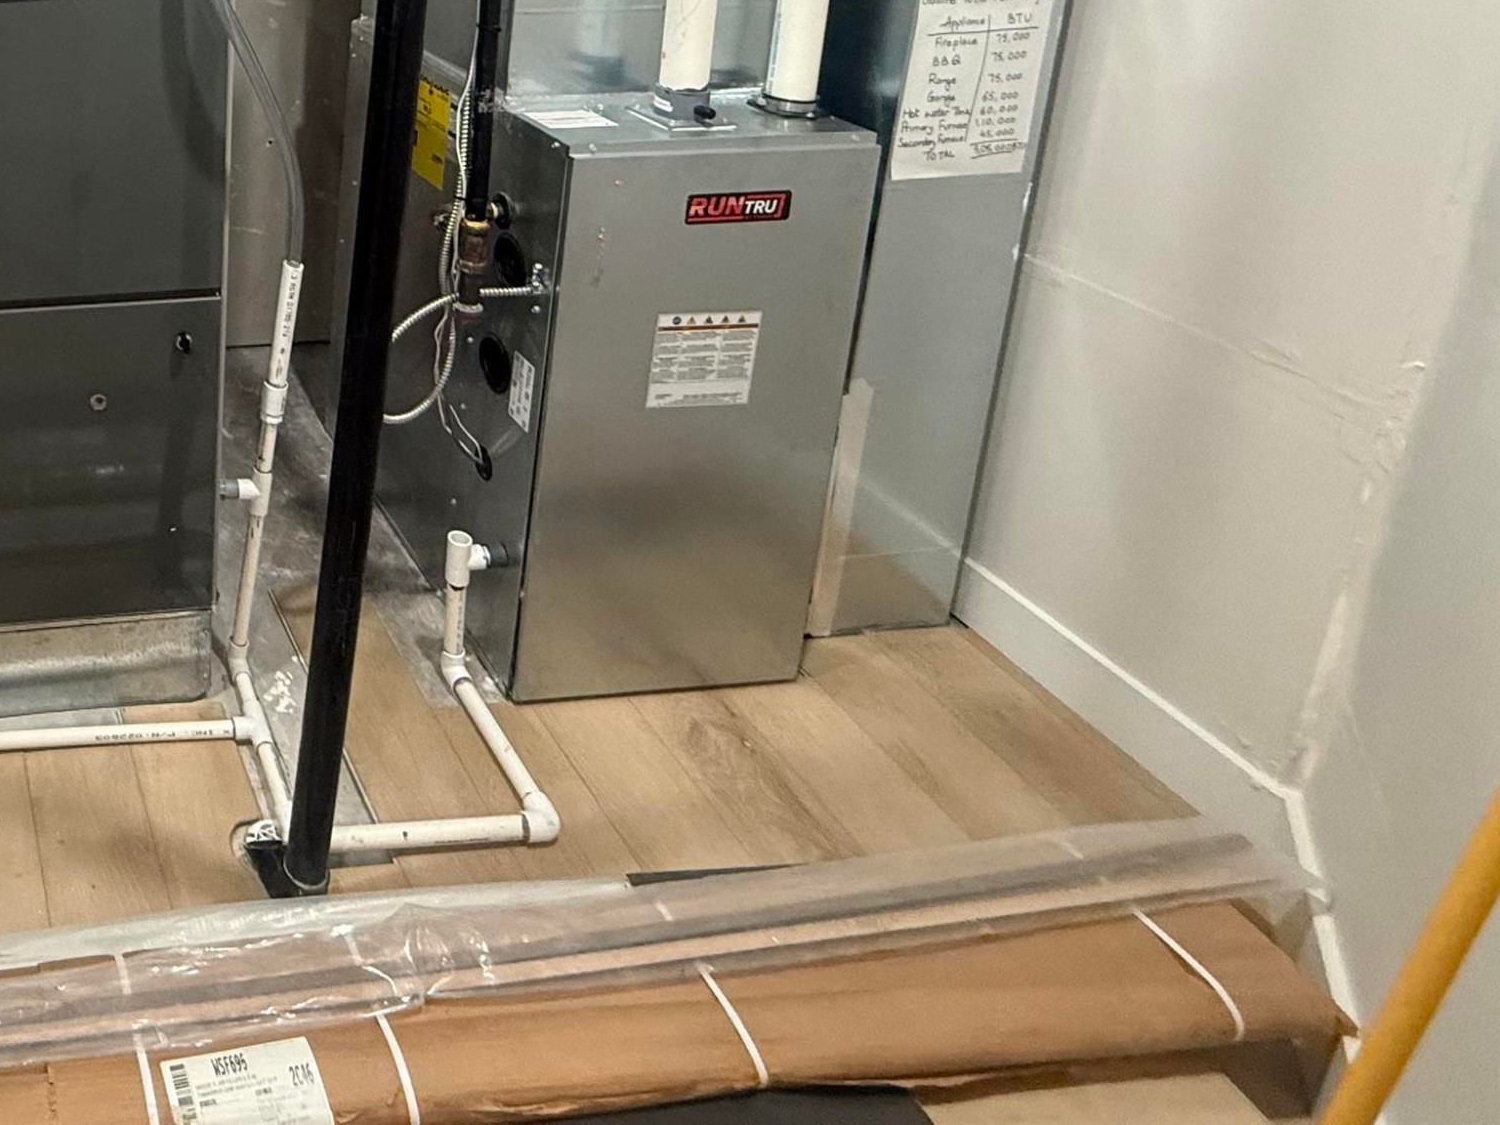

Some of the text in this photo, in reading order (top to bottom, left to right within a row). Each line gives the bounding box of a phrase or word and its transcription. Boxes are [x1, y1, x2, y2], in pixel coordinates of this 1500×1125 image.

[939, 13, 1033, 29] Appliance BTU
[928, 73, 957, 91] Range
[903, 108, 920, 119] Hot
[689, 196, 778, 216] RUNTRU
[211, 1053, 248, 1077] WSF695
